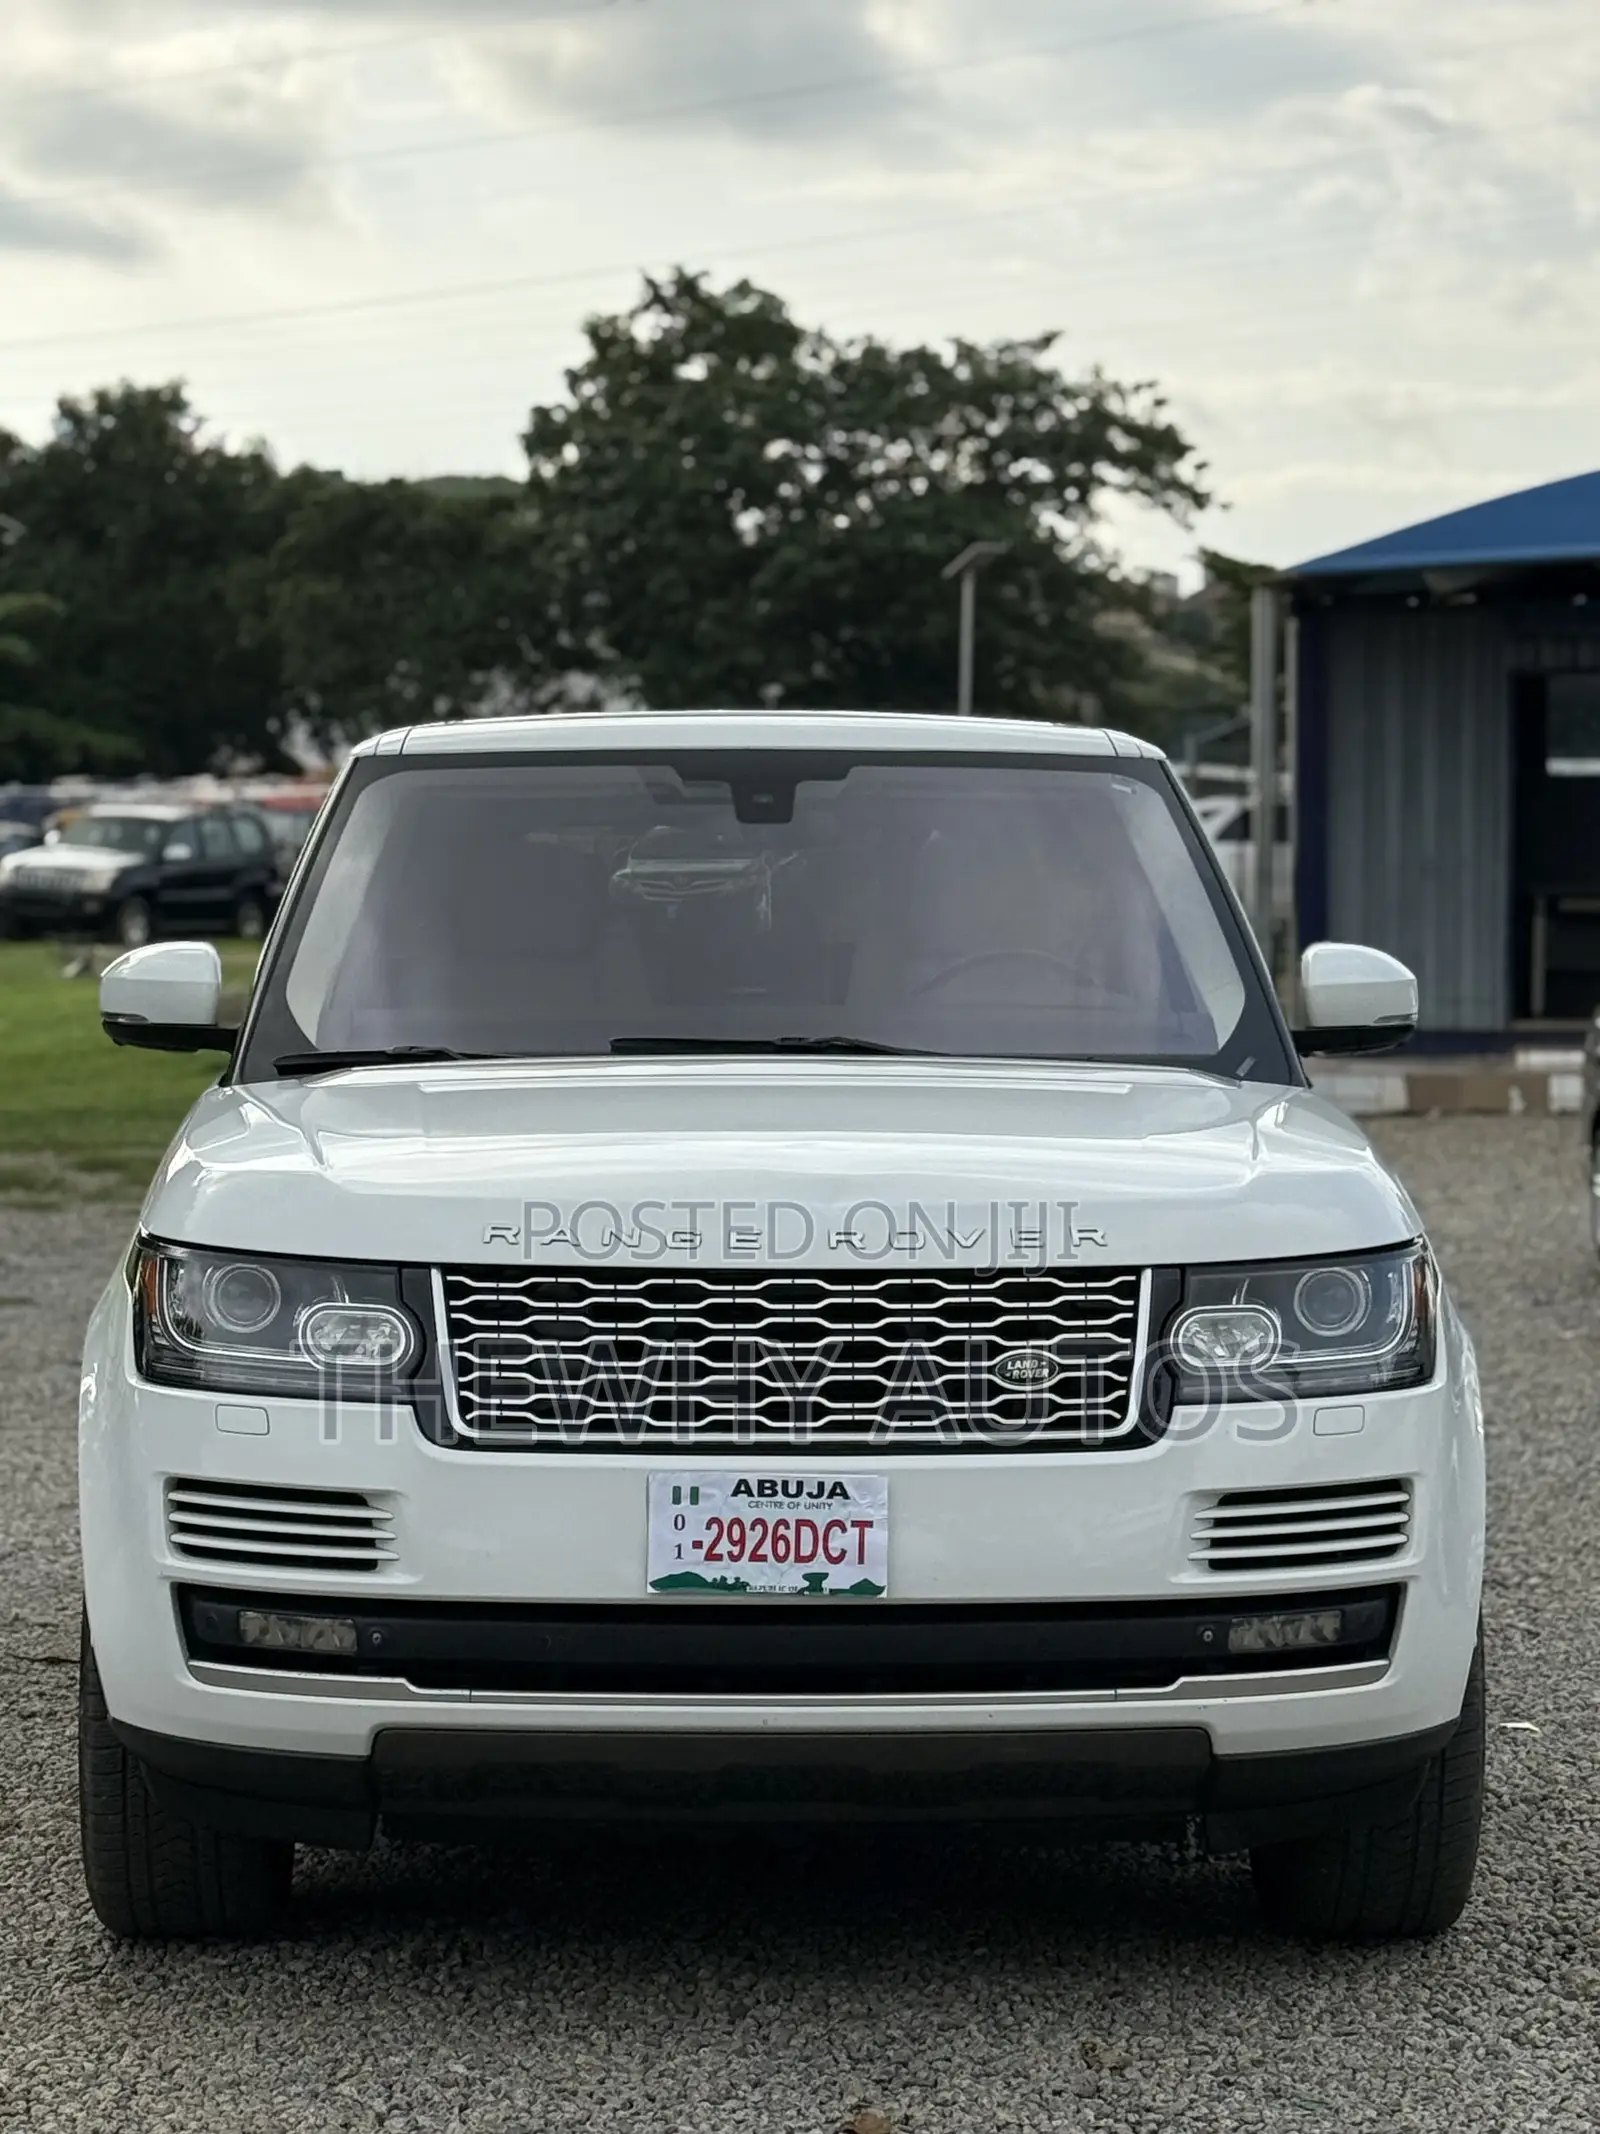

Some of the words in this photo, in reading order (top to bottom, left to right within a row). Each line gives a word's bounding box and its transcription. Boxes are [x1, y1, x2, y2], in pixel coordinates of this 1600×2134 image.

[482, 1223, 763, 1250] RANGE
[827, 1226, 1108, 1251] ROVER
[1007, 1360, 1039, 1370] LAND
[1012, 1368, 1050, 1380] ROVER
[731, 1479, 850, 1499] ABUJA
[748, 1500, 785, 1509] CENTRE
[787, 1501, 801, 1510] OF
[804, 1502, 833, 1510] UNITY
